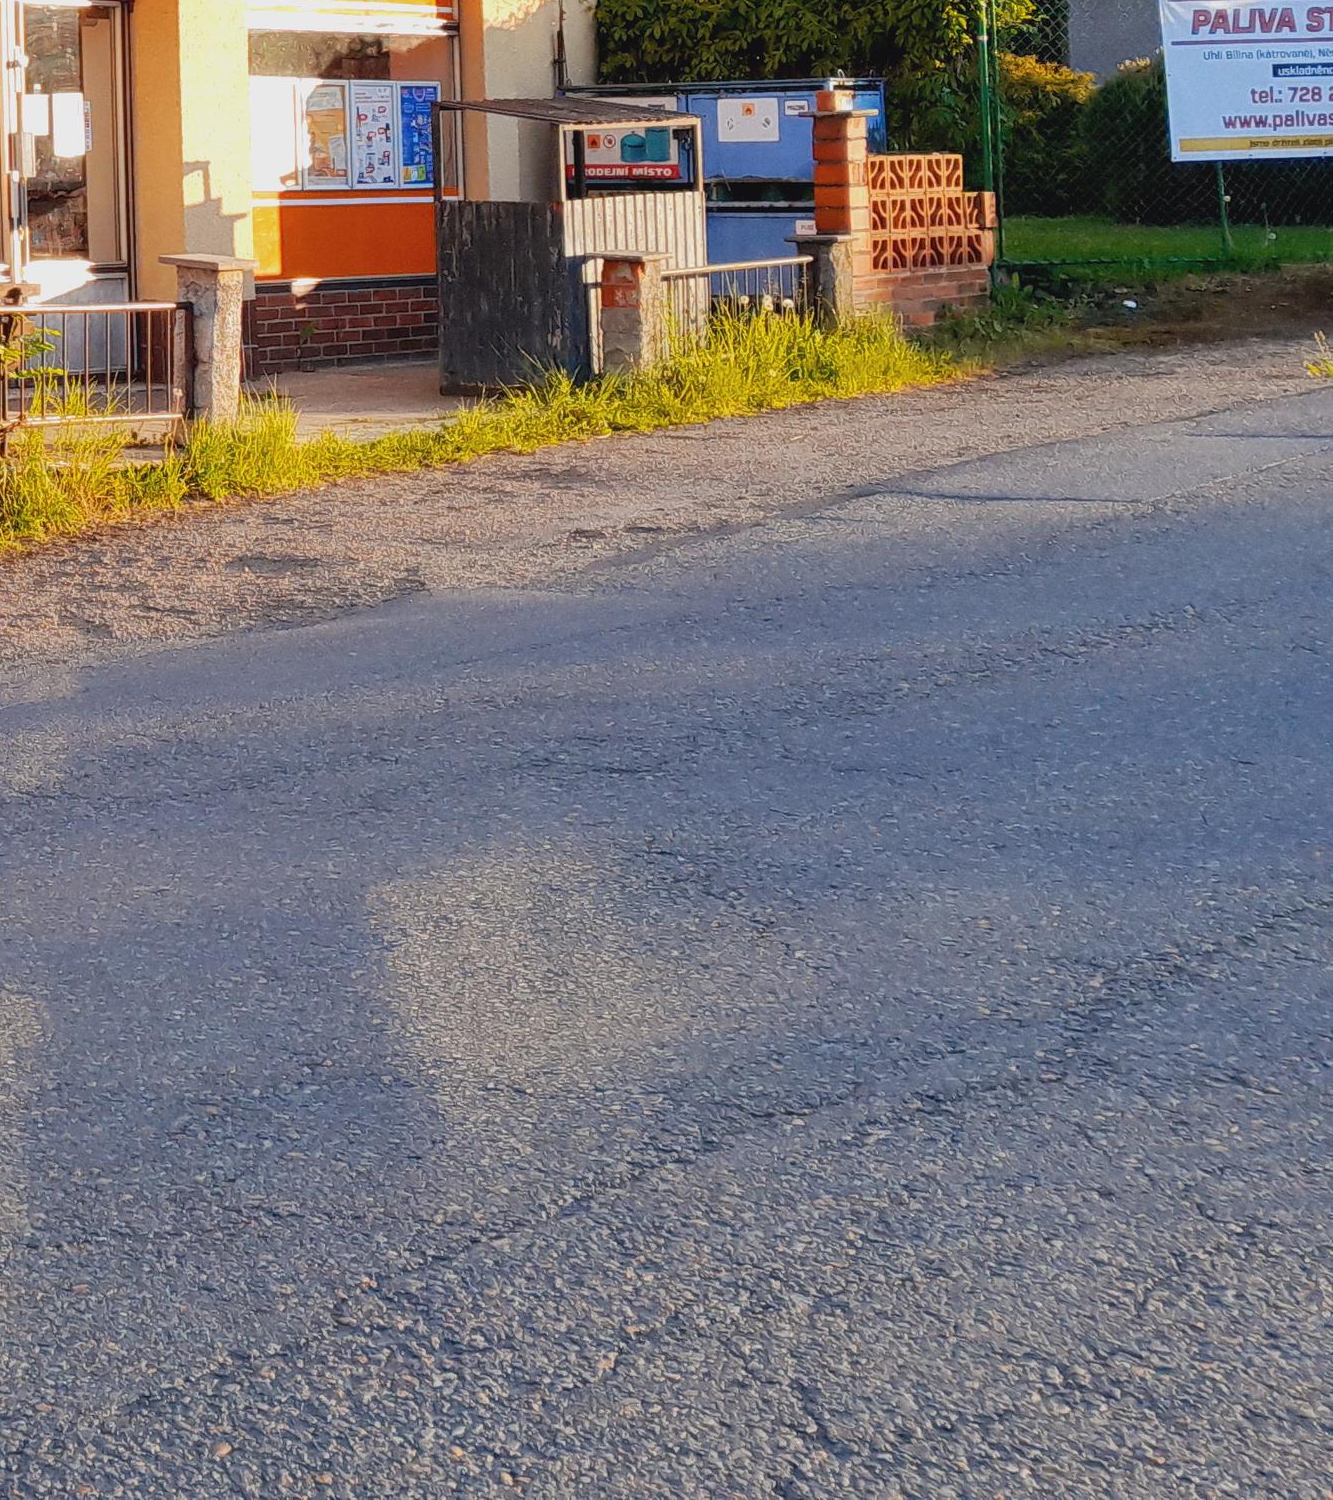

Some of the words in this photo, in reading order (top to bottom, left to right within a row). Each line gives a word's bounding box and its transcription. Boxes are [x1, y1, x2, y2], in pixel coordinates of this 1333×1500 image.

[1191, 7, 1297, 35] PALIVA
[1250, 85, 1283, 104] tel.:
[1287, 86, 1322, 103] 728
[572, 166, 629, 176] ODEJNÍ
[632, 166, 672, 176] MÍSTO
